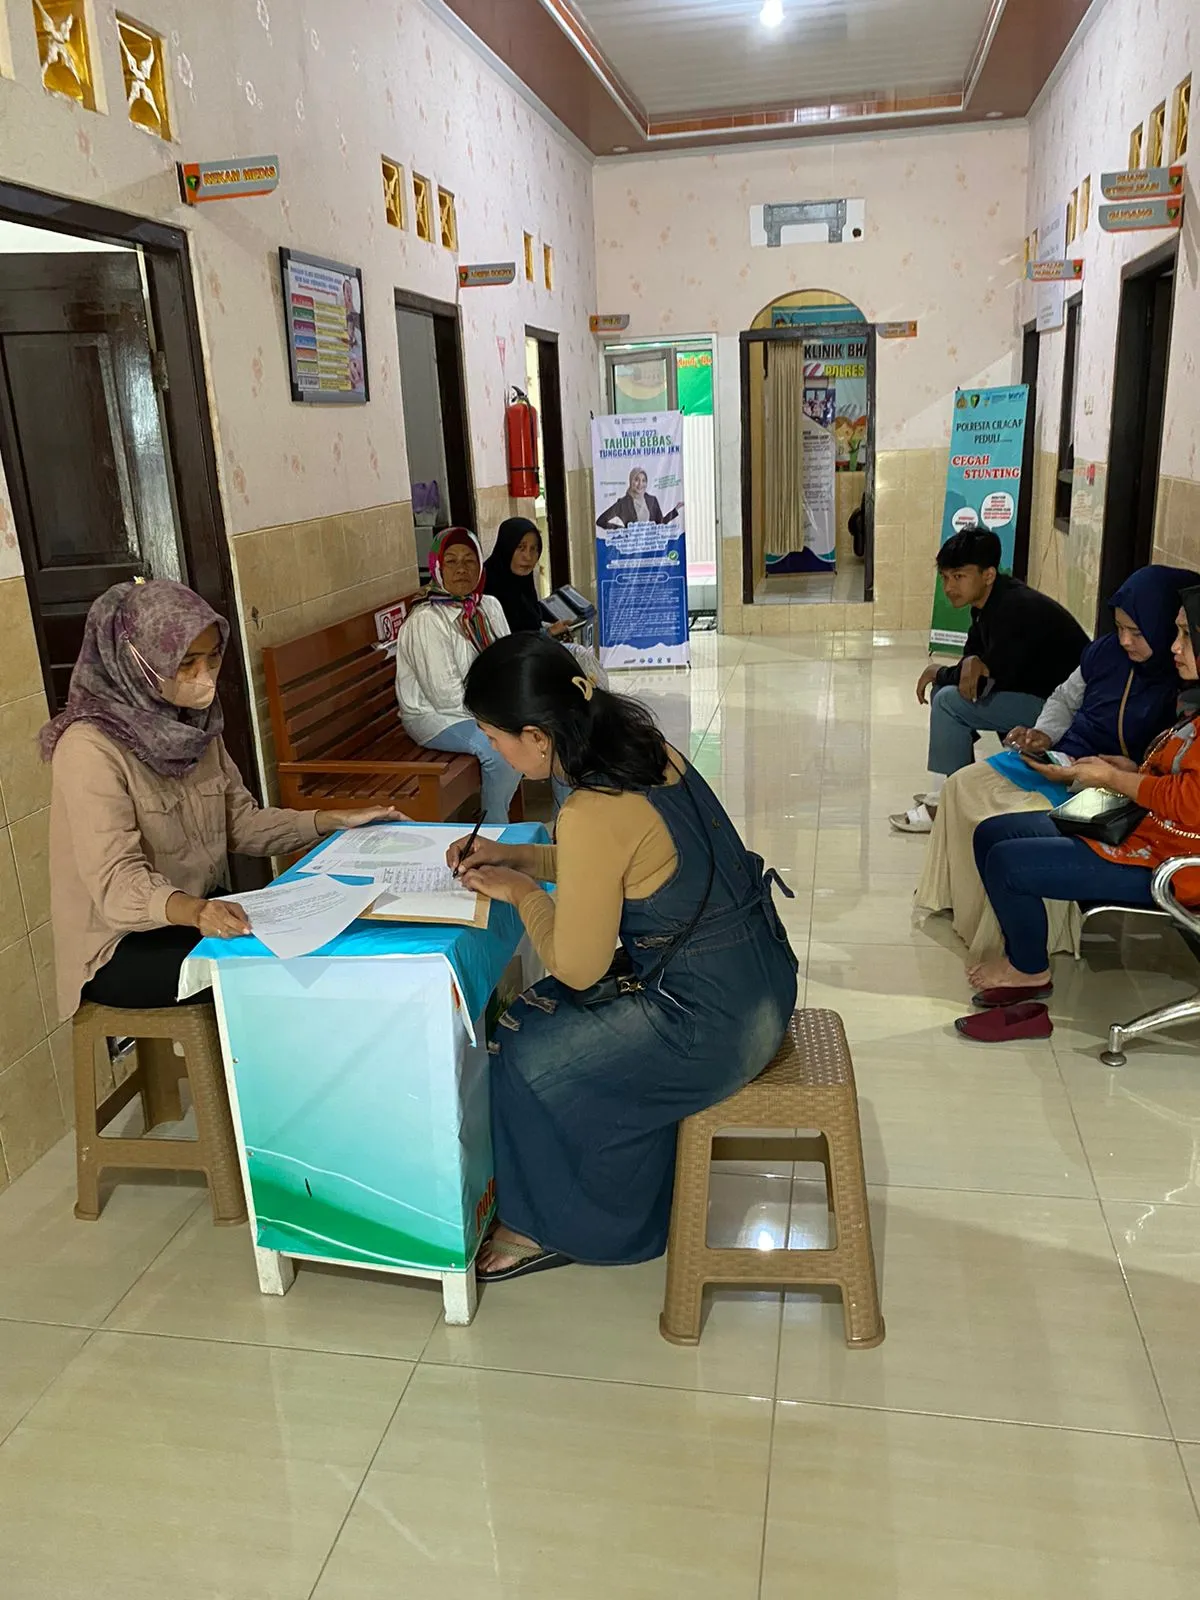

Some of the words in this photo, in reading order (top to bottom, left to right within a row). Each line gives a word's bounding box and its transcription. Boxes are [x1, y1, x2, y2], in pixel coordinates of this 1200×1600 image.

[804, 343, 842, 359] KLINIK
[824, 363, 865, 378] POLRES
[956, 421, 990, 432] POLRESTA
[992, 418, 1023, 430] CILACAP
[604, 438, 636, 449] TAHUN
[640, 435, 672, 447] BEBAS
[600, 447, 640, 458] TUNGGAKAN
[643, 446, 665, 456] IURAN
[668, 445, 680, 454] JKN
[951, 454, 990, 467] CEGAH
[964, 467, 1020, 480] STUNTING
